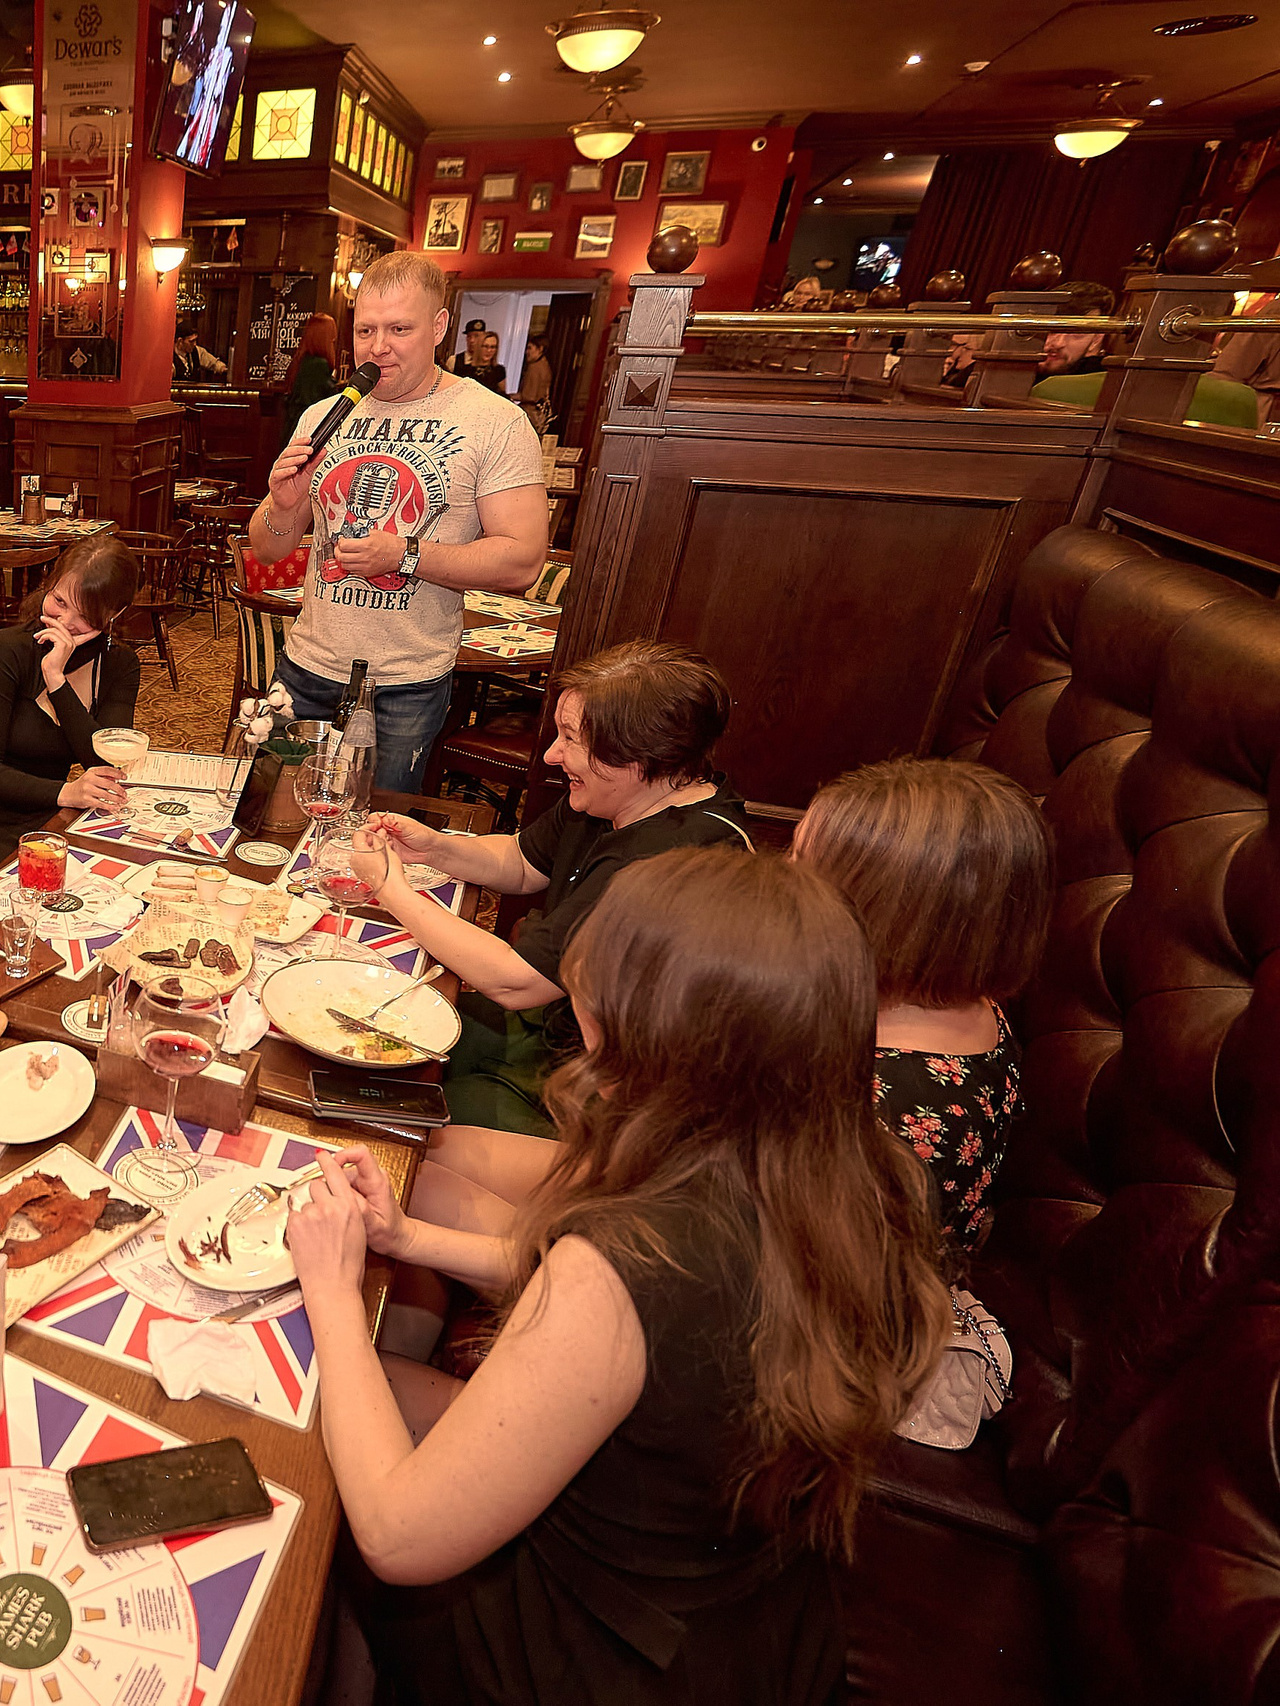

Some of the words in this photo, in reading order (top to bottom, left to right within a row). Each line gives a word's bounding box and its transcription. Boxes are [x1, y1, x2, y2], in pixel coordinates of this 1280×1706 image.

[55, 35, 122, 60] Dewar's
[343, 417, 443, 443] MAKE
[348, 441, 383, 457] ROCK
[397, 444, 428, 471] ROLL
[421, 472, 444, 511] MUSIC
[314, 581, 327, 600] IT
[331, 584, 411, 611] LOUDER
[6, 1592, 46, 1651] SHARK
[25, 1611, 53, 1648] PUB
